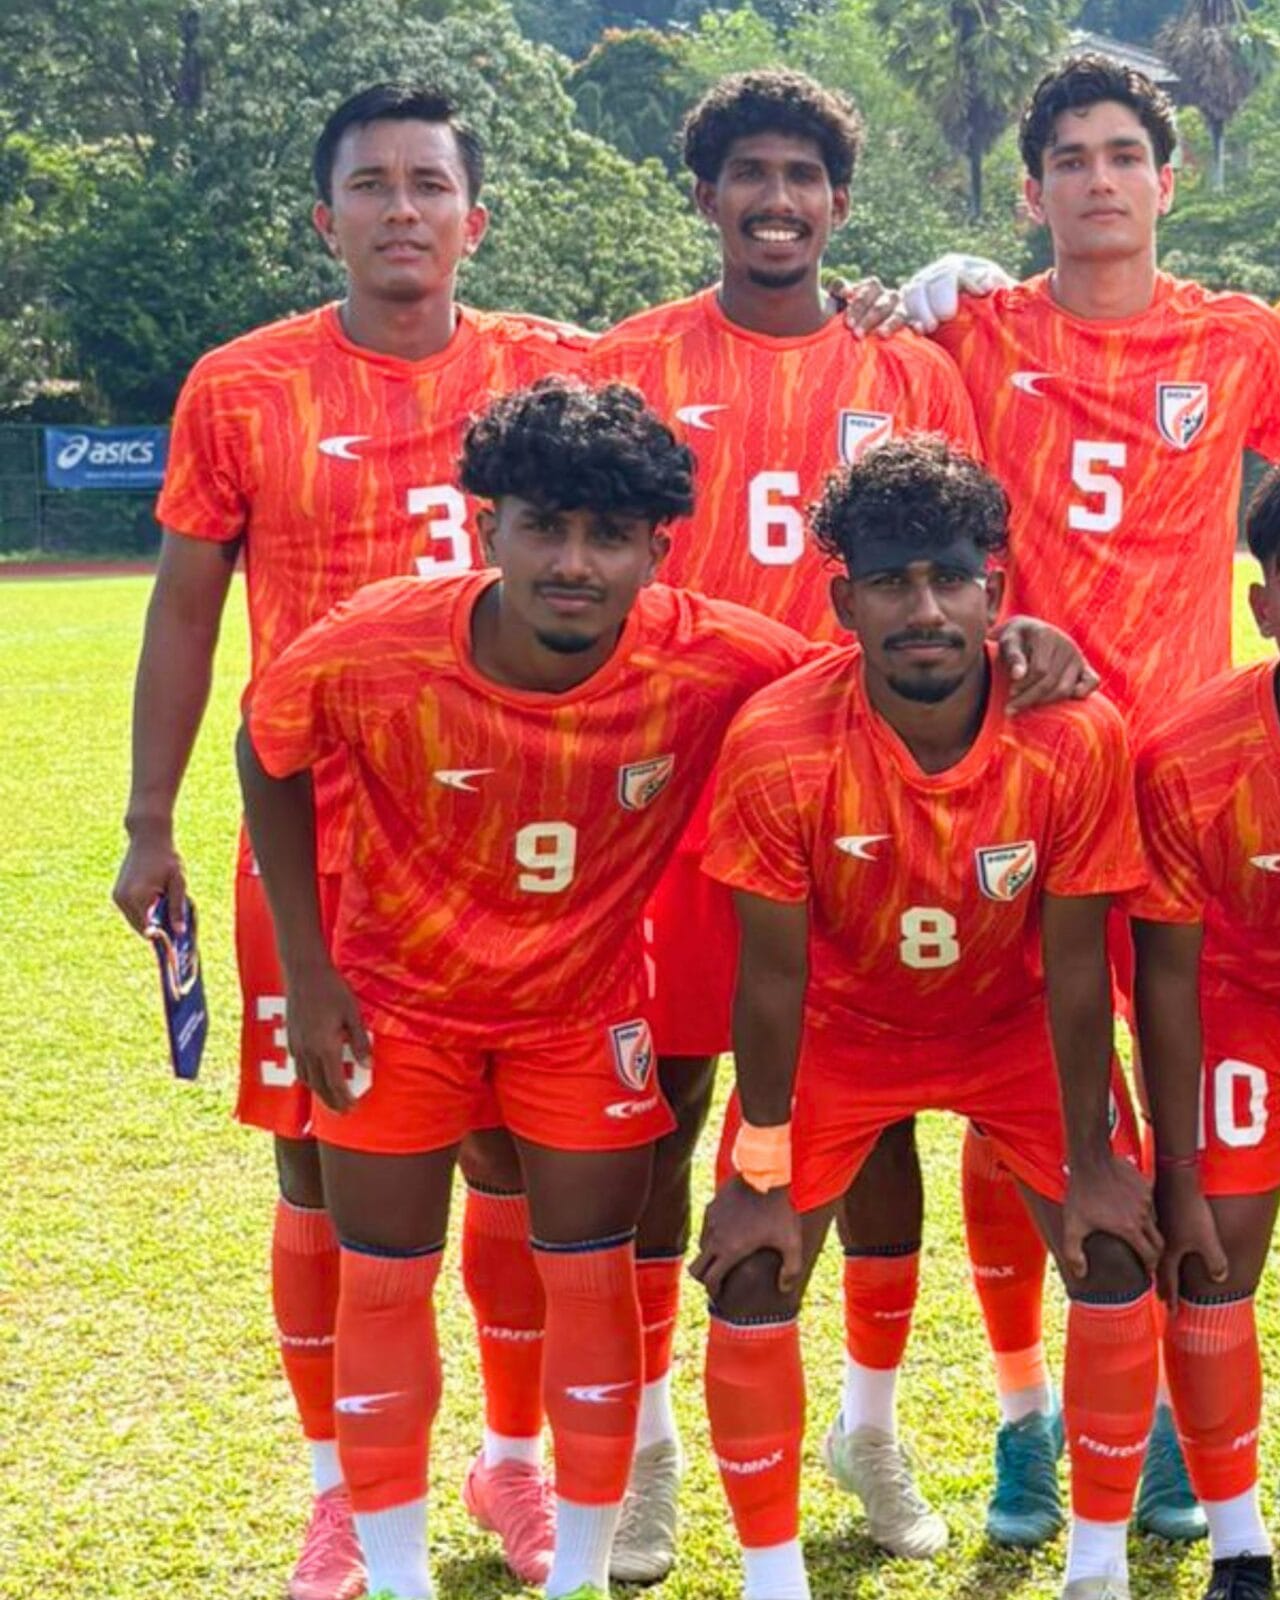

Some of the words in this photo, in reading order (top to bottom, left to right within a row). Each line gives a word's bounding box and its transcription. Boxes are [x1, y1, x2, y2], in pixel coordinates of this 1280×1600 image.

[407, 484, 473, 577] 3
[747, 470, 806, 566] 6
[1067, 439, 1128, 533] 5
[515, 820, 578, 893] 9
[900, 906, 960, 969] 8
[257, 995, 298, 1088] 3
[1198, 1058, 1269, 1150] 0
